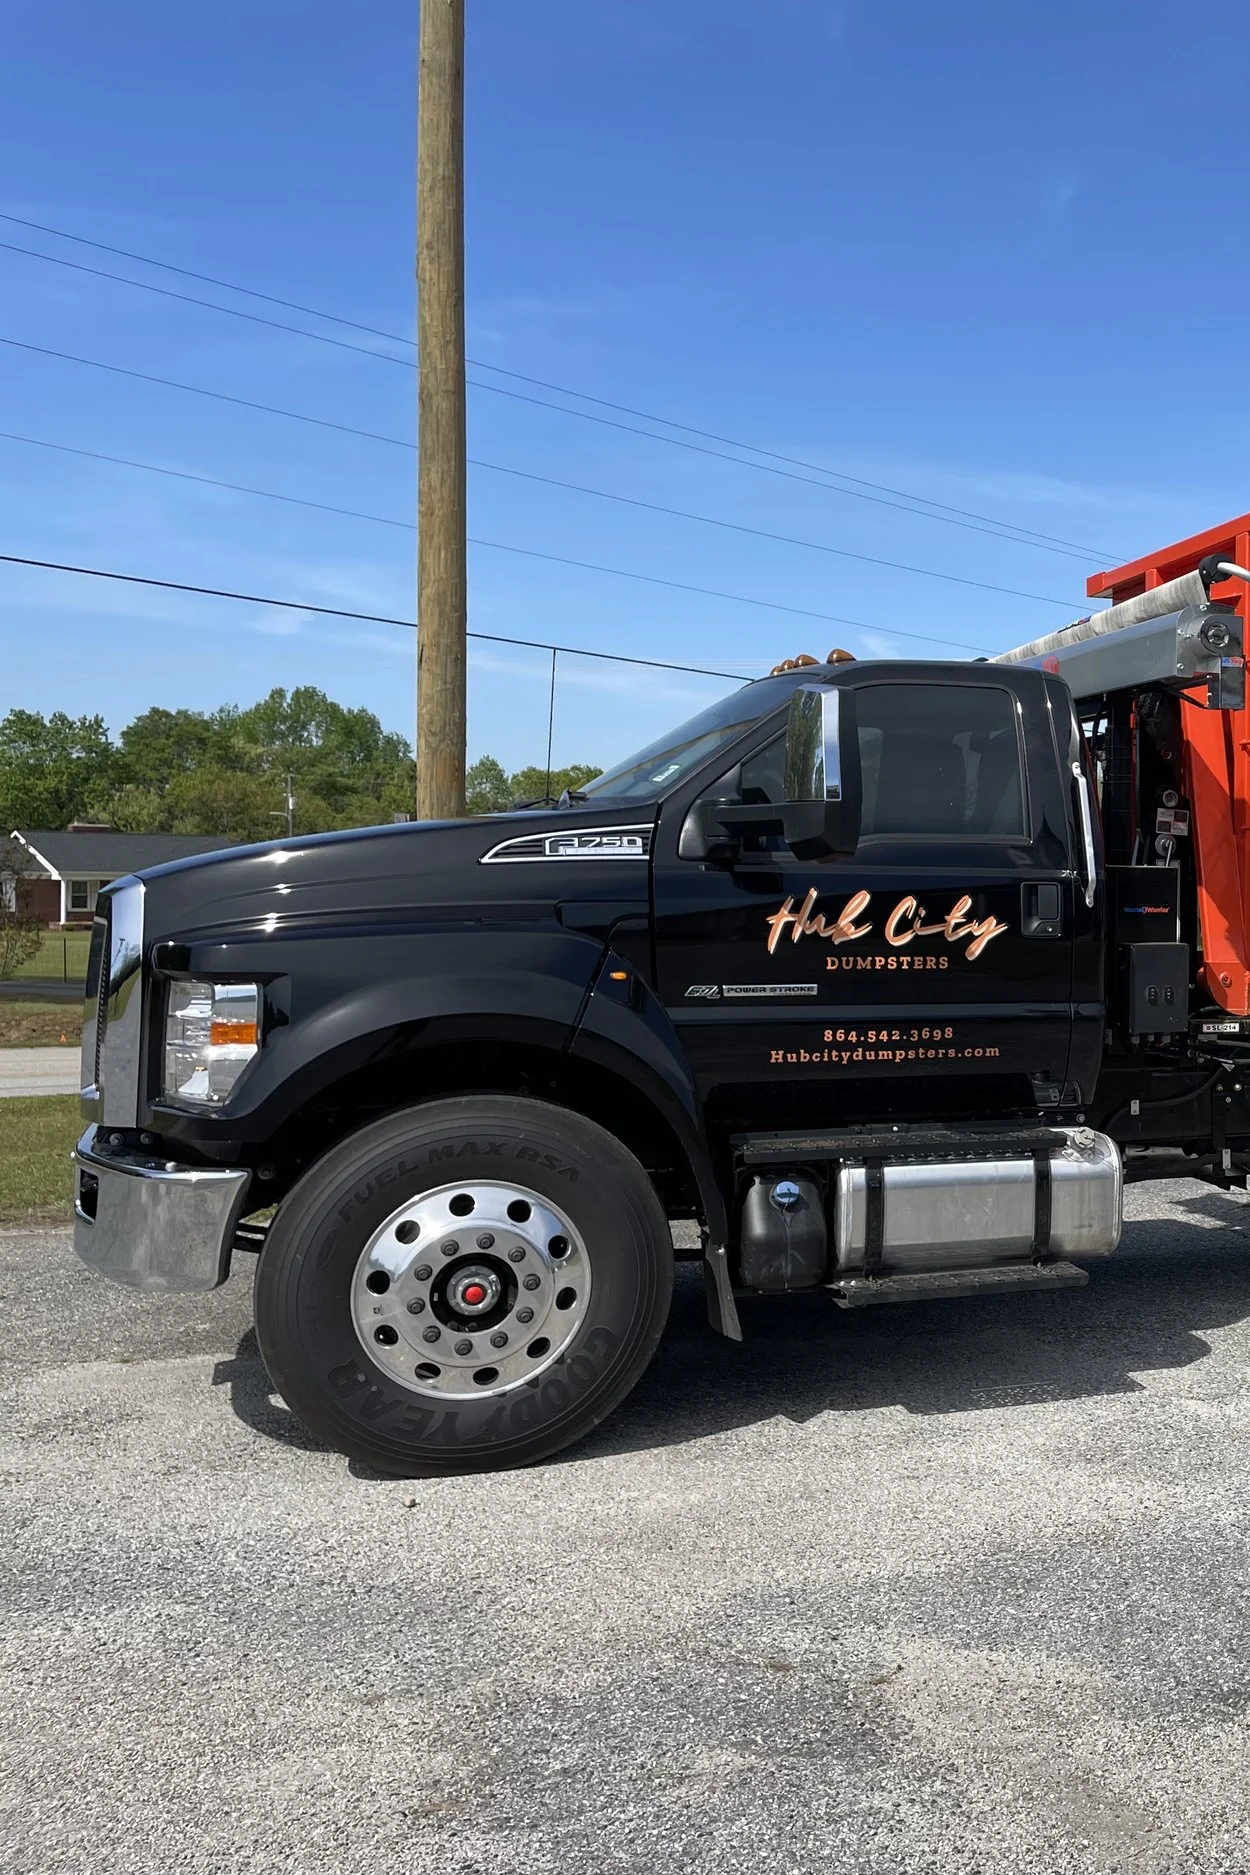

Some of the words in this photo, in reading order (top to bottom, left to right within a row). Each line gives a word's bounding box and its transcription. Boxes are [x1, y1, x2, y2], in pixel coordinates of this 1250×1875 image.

[766, 887, 874, 955] Hub
[885, 894, 1009, 961] City
[826, 956, 950, 971] DUMPSTERS
[726, 986, 767, 994] POWER
[769, 985, 815, 993] STROKE
[823, 1027, 954, 1043] 864.542.3698
[770, 1045, 1001, 1064] Hubcitydumpsters.com
[337, 1160, 419, 1224] FUEL
[427, 1141, 510, 1165] MAX
[515, 1144, 582, 1184] RSA
